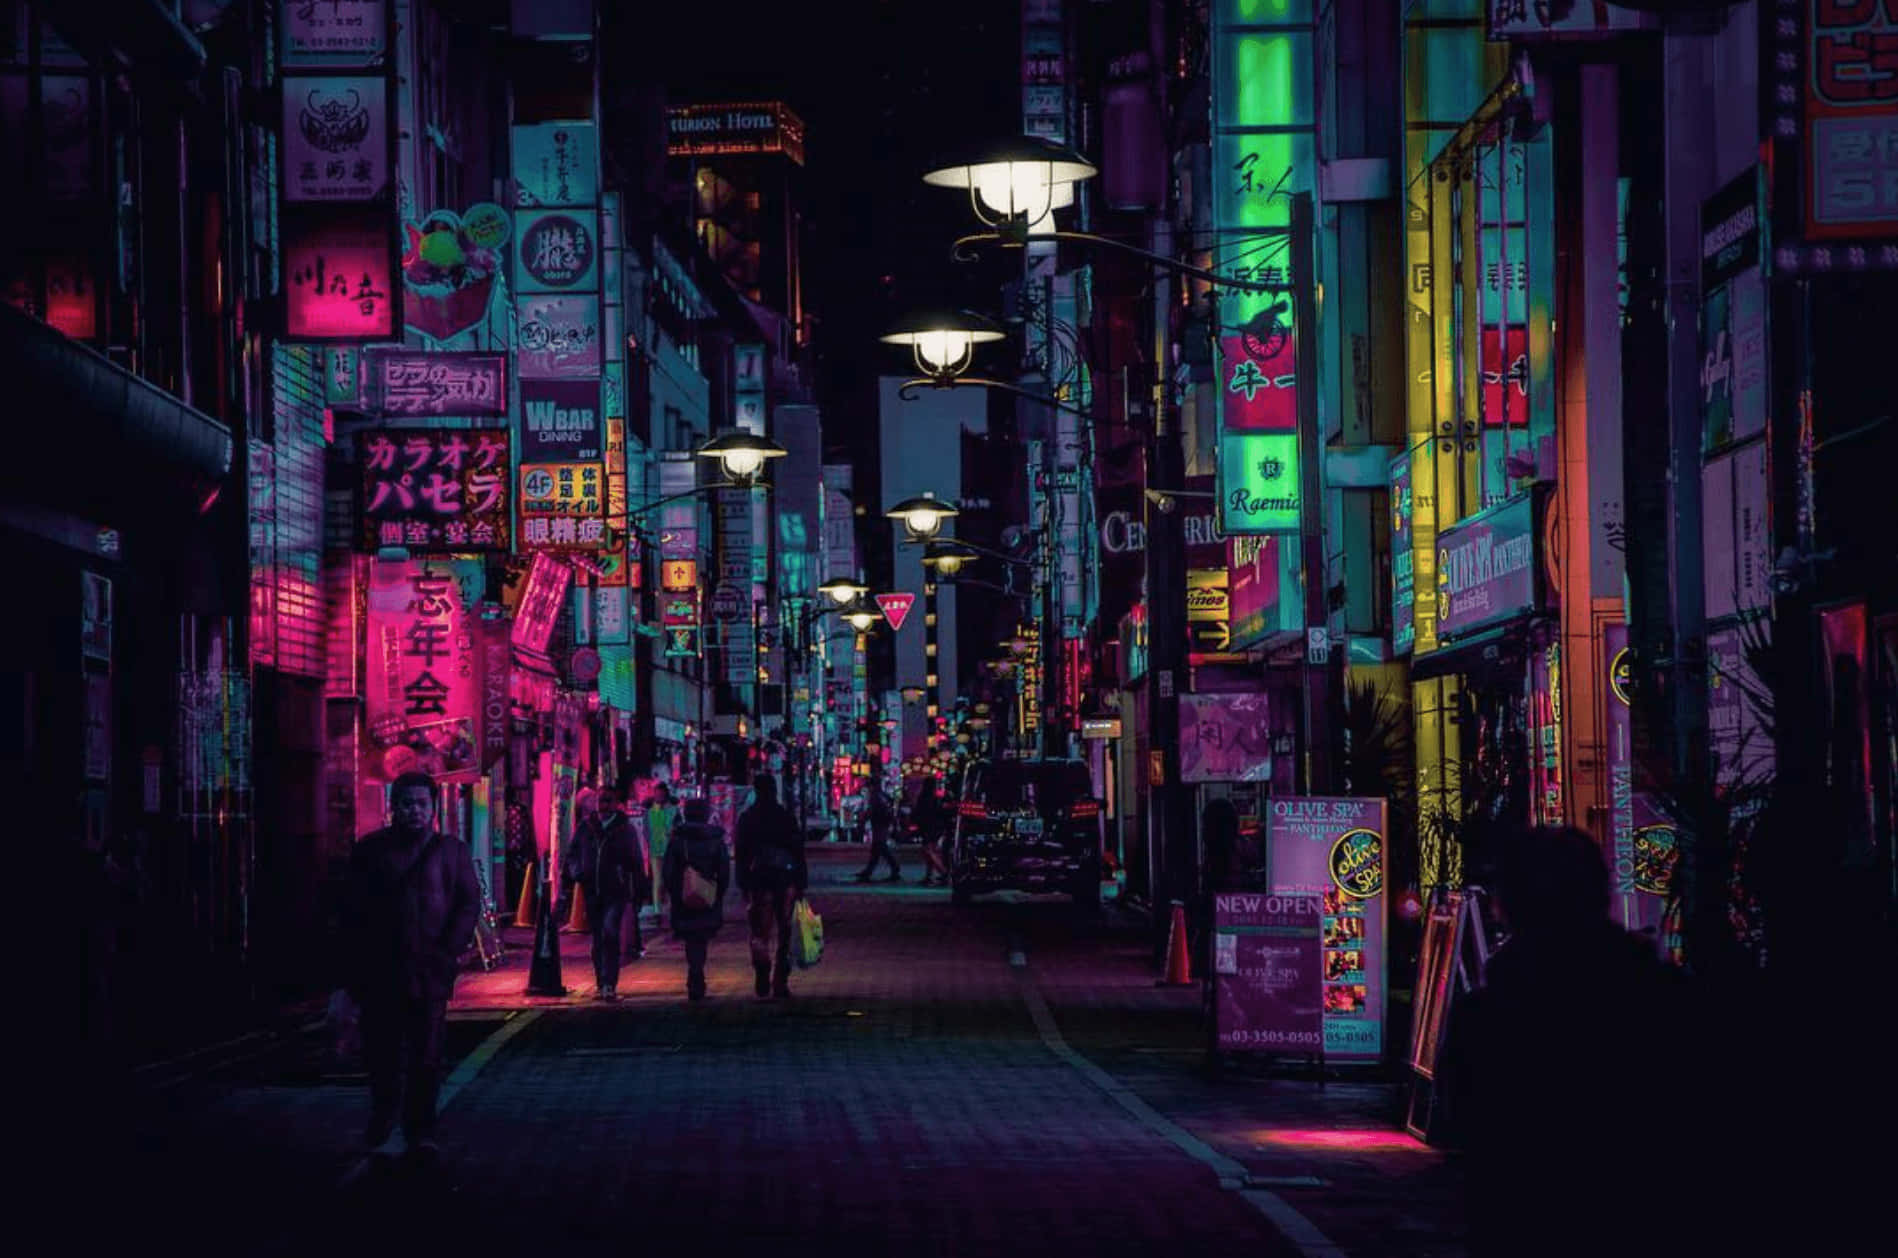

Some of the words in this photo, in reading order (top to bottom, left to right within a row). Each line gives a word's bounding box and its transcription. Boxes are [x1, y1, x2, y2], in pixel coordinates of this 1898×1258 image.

[538, 432, 583, 443] DINING
[366, 436, 506, 473] カラオケ
[367, 473, 504, 513] パセラ
[1187, 592, 1226, 607] imes
[402, 562, 453, 717] 忘年会
[484, 644, 503, 749] KARAOKE
[1274, 801, 1327, 818] OLIVE
[1333, 802, 1362, 818] SPA
[1614, 766, 1635, 893] PANTHEON
[1216, 897, 1260, 914] NEW
[1266, 897, 1320, 916] OPEN
[1231, 1031, 1322, 1045] 03-3505-0505
